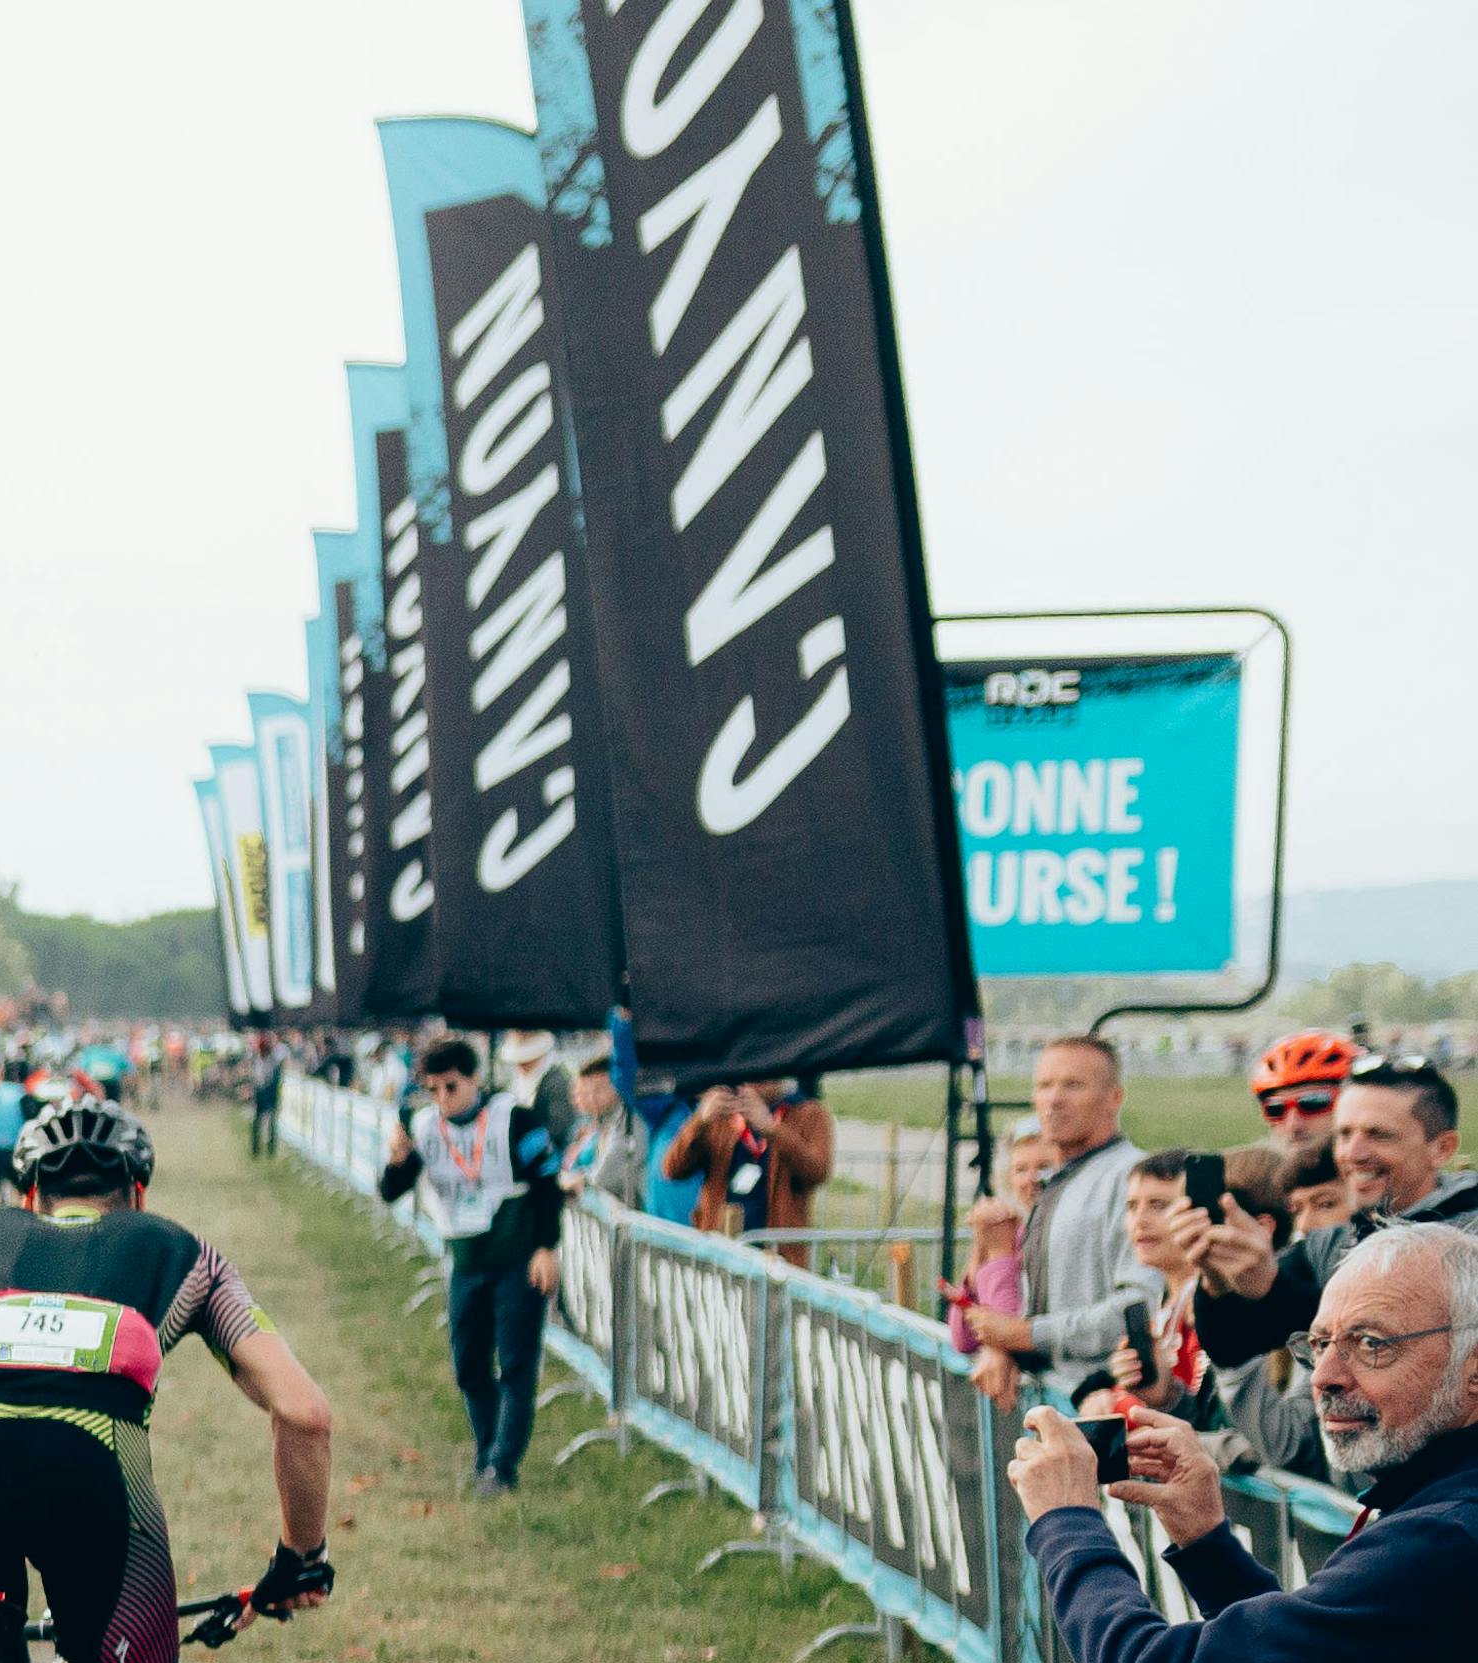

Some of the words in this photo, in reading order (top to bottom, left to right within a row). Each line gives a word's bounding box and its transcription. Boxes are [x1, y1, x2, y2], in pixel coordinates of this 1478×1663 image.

[608, 0, 851, 836] CANYO
[450, 243, 576, 894] CANYON
[985, 668, 1081, 707] ROC
[951, 757, 1144, 838] ONNE
[967, 847, 1144, 926] URSE
[1154, 847, 1179, 923] !
[20, 1312, 64, 1334] 745
